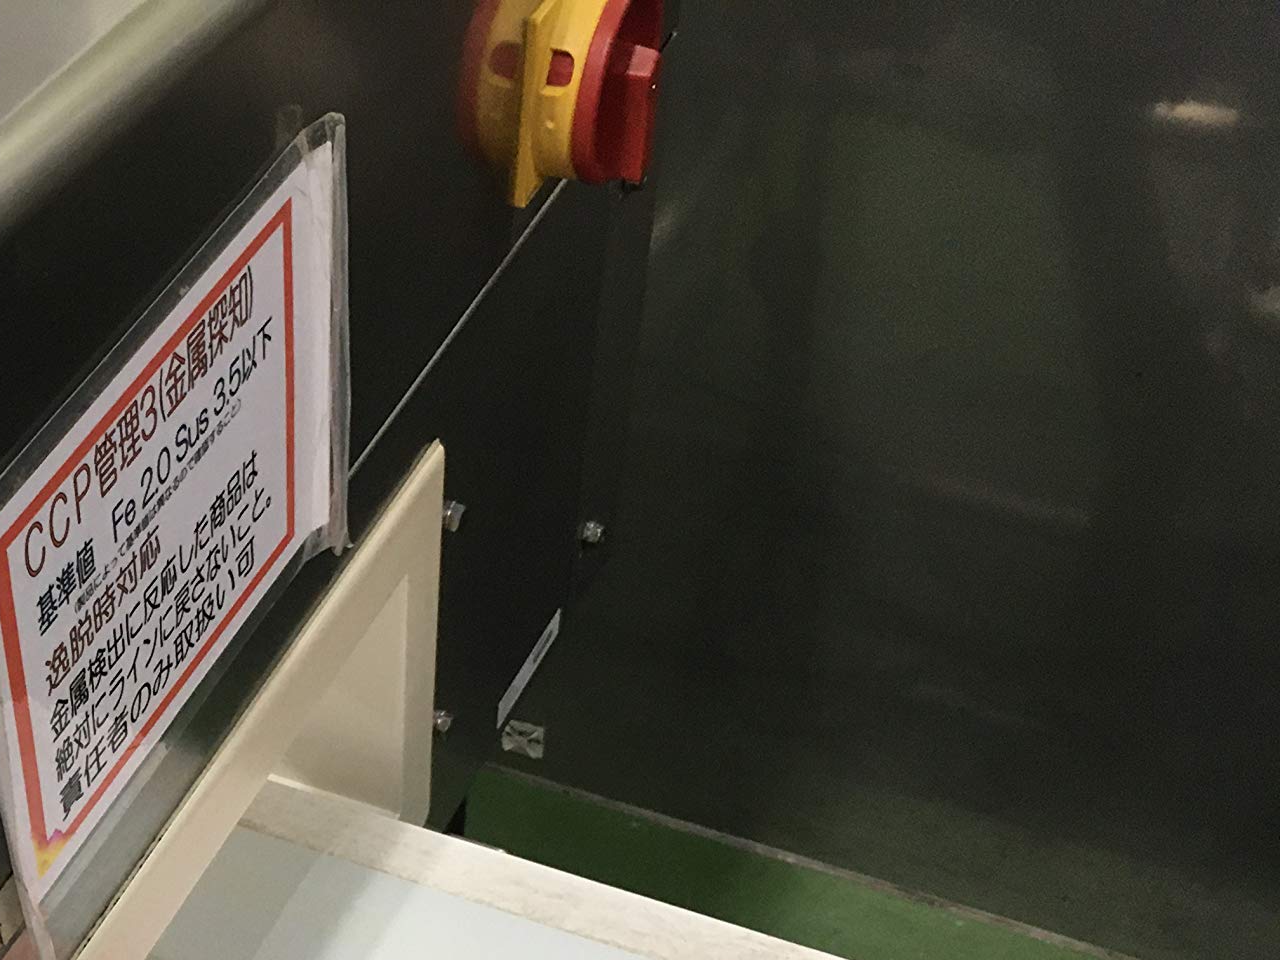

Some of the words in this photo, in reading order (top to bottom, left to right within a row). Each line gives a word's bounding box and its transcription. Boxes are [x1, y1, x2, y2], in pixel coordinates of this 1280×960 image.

[35, 538, 96, 636] 基準値
[111, 498, 136, 543] Fe
[140, 446, 171, 510] 2.0
[175, 408, 210, 462] Sus
[45, 524, 161, 697] 逸脱時対応
[49, 449, 258, 744] 金属検出に反応した商品は
[55, 486, 272, 783] 絶対にラインに戻さないこと。
[59, 536, 256, 822] 責任者のみ取扱い可
